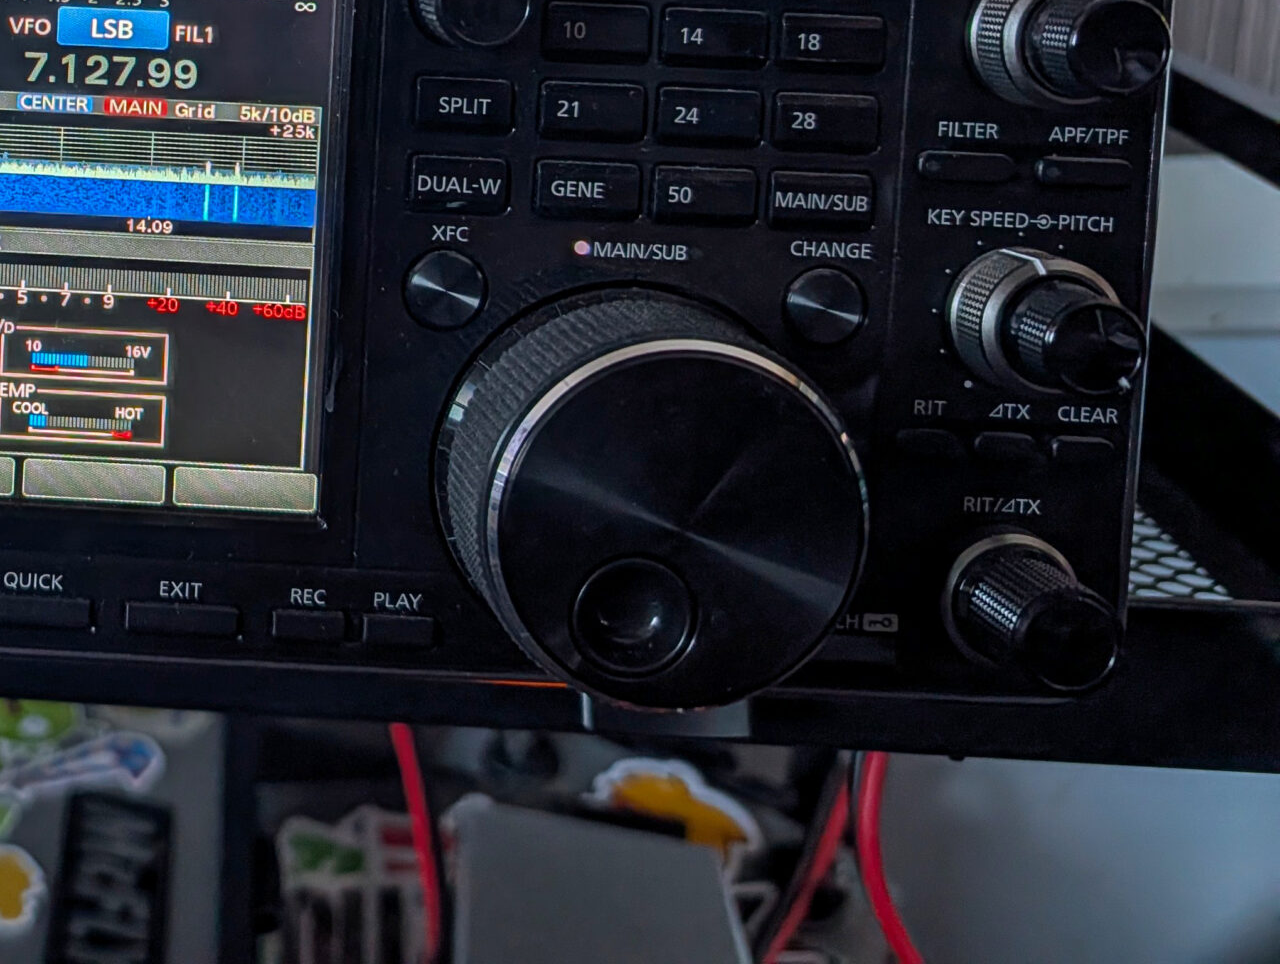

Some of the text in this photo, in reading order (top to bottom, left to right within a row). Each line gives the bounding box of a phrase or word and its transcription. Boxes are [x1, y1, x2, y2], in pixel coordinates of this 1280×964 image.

[8, 17, 51, 35] VFO
[91, 18, 133, 40] LSB
[175, 25, 214, 44] FIL1
[563, 21, 586, 39] 10
[681, 27, 704, 45] 14
[798, 33, 821, 51] 18
[24, 50, 198, 90] 7.127.99
[20, 94, 88, 112] CENTER
[109, 99, 162, 116] MAIN
[175, 102, 216, 119] Grid
[438, 96, 492, 115] SPLIT
[556, 100, 580, 118] 21
[674, 106, 699, 124] 24
[791, 112, 817, 130] 28
[938, 121, 999, 139] FILTER
[1048, 126, 1130, 144] APF/TPF
[417, 175, 502, 195] DUAL-W
[550, 180, 605, 199] GENE
[668, 187, 692, 204] 50
[775, 191, 868, 212] MAIN/SUB
[927, 208, 1114, 233] KEY SPEED PITCH
[431, 225, 470, 242] XFC
[593, 241, 688, 261] MAIN/SUB
[790, 240, 873, 259] CHANGE
[12, 401, 48, 415] COOL
[115, 407, 143, 421] HOT
[914, 399, 947, 416] RIT
[1057, 405, 1118, 424] CLEAR
[3, 571, 63, 591] QUICK
[160, 580, 202, 600] EXIT
[290, 588, 326, 605] REC
[373, 592, 421, 610] PLAY
